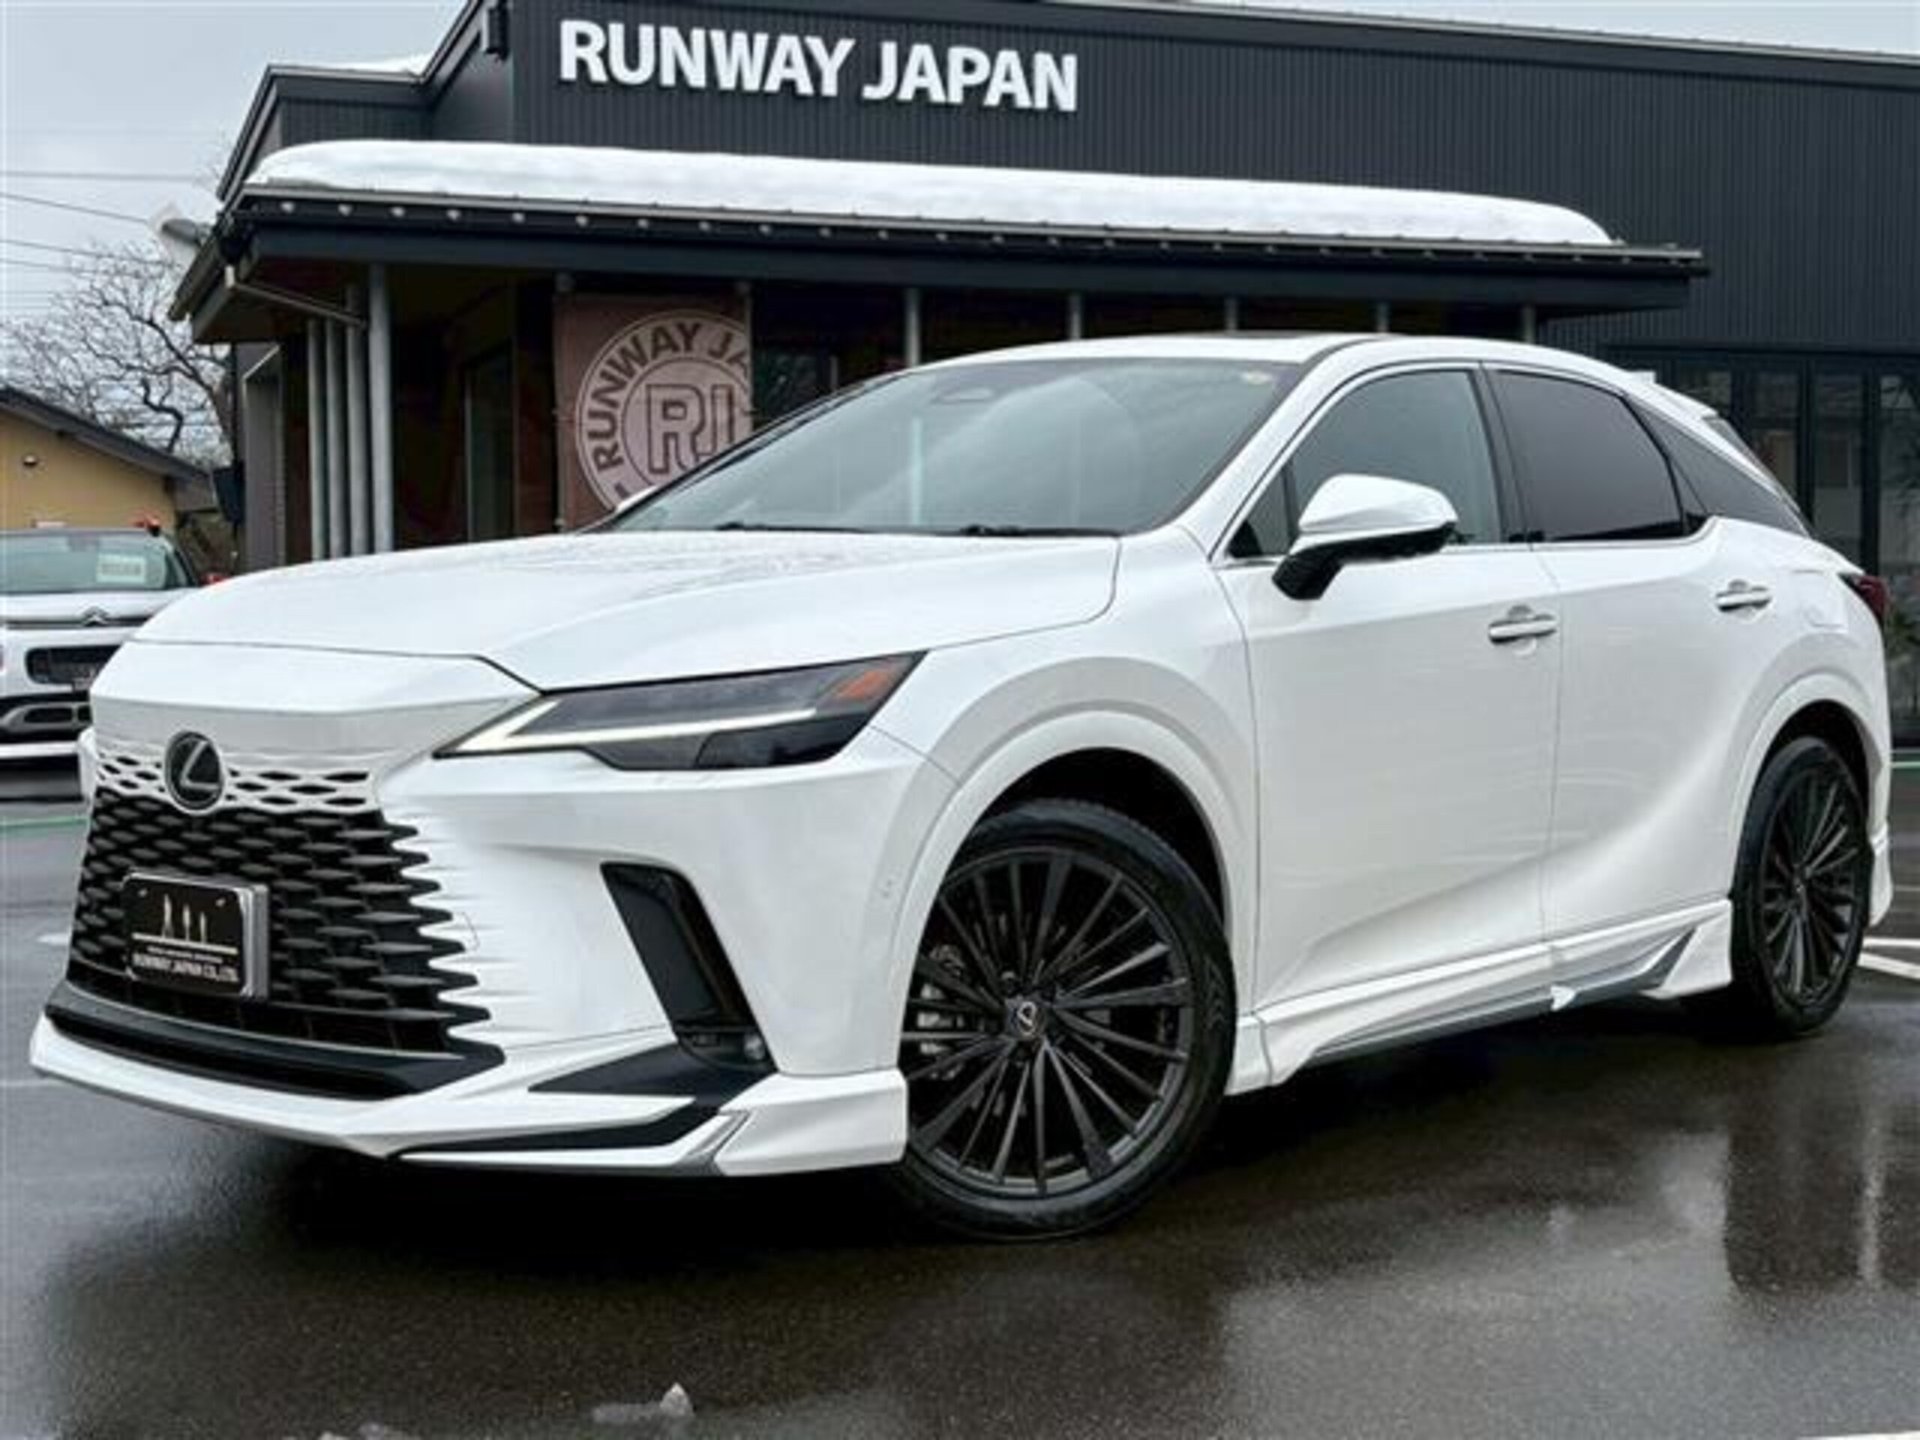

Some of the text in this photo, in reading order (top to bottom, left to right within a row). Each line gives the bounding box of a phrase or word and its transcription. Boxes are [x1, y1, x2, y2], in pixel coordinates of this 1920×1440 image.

[559, 19, 1078, 112] RUNWAY JAPAN
[587, 321, 700, 473] RUNWAY
